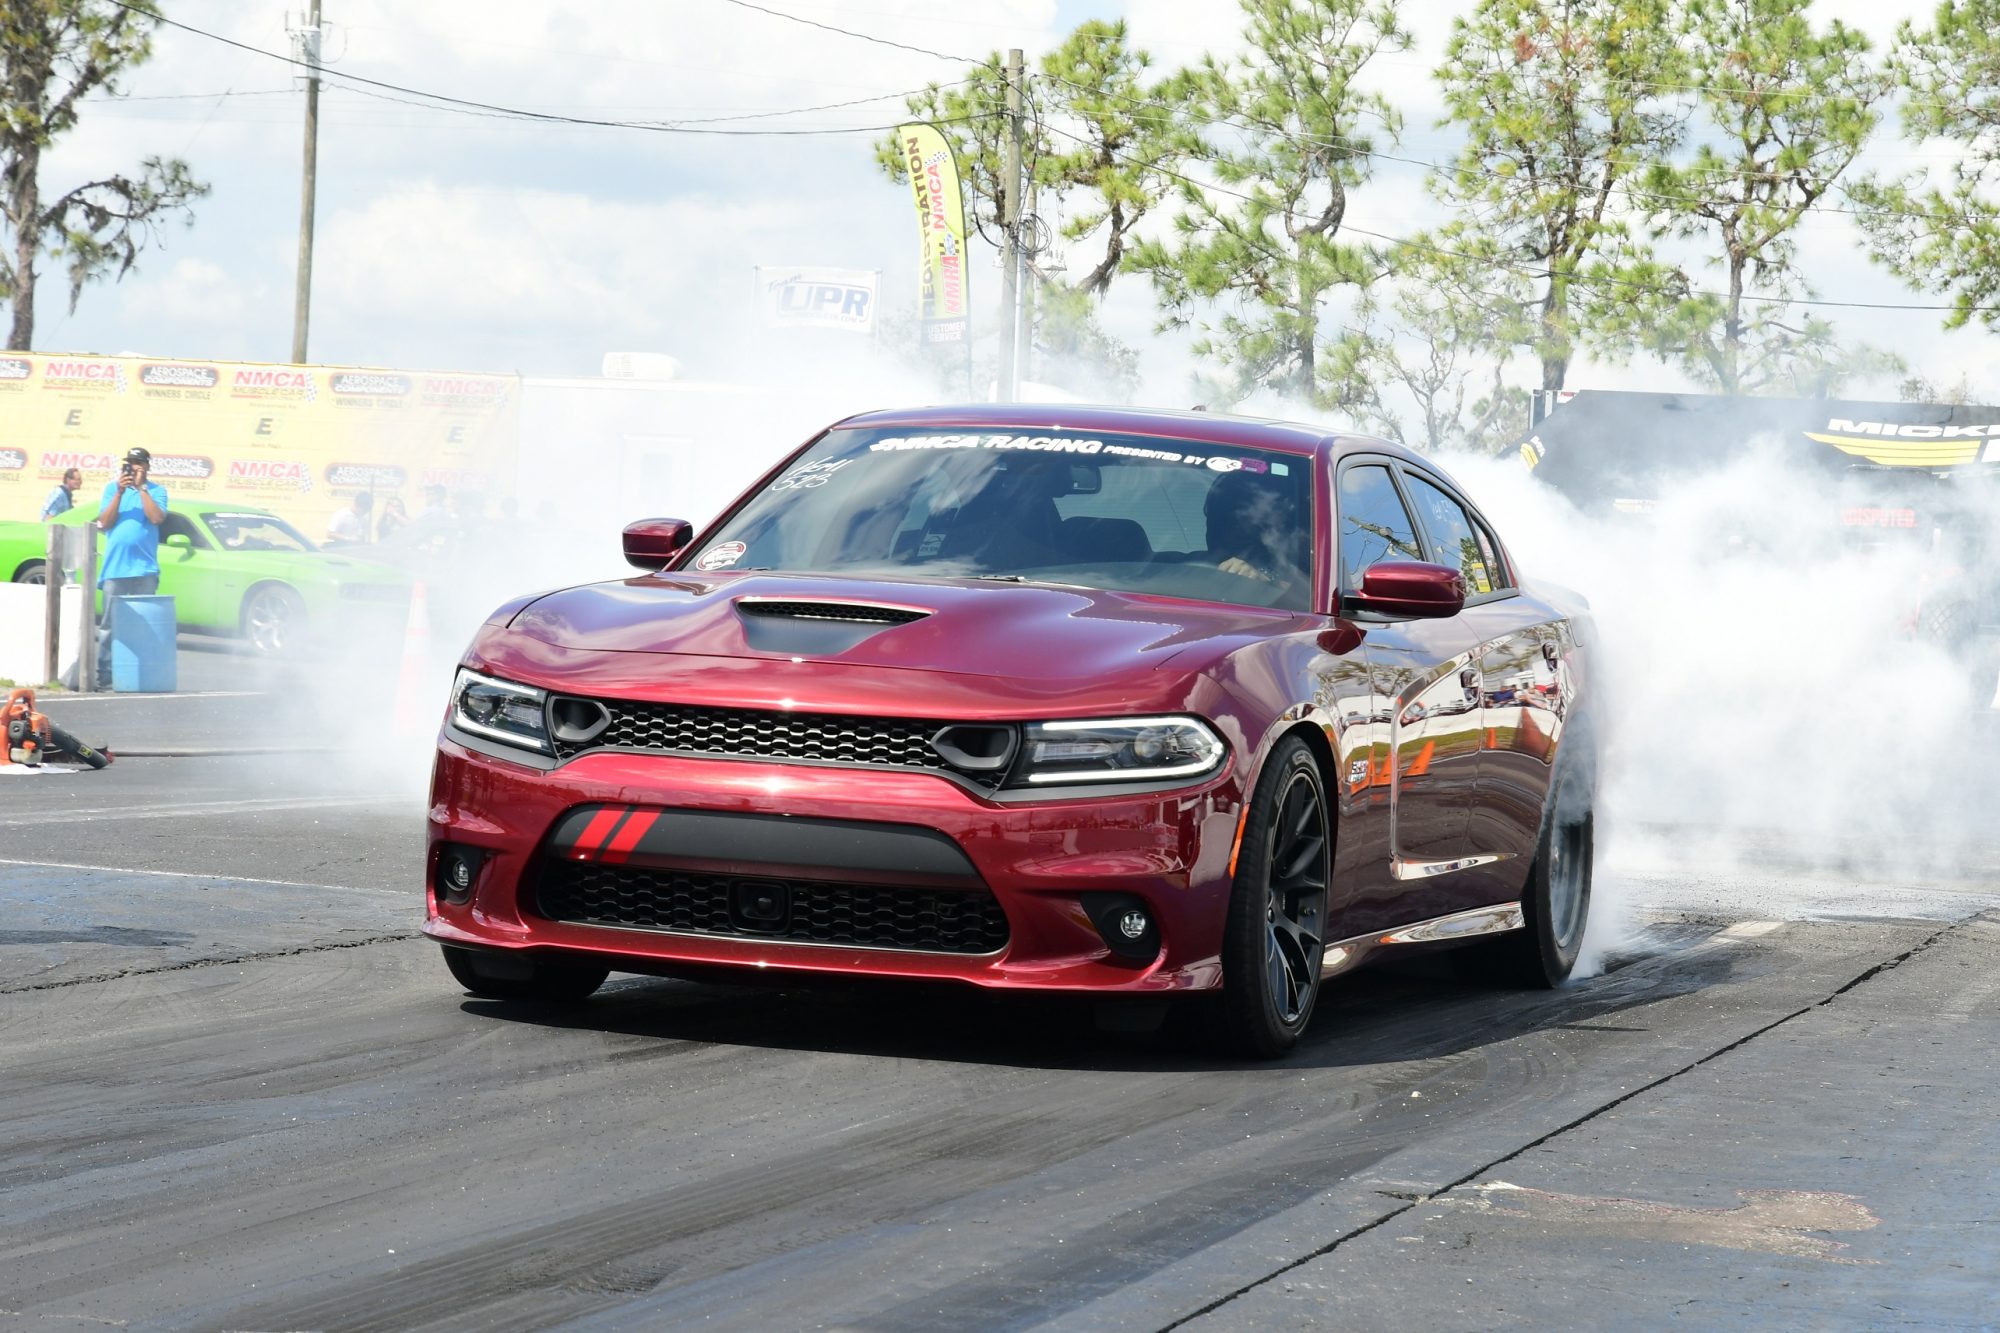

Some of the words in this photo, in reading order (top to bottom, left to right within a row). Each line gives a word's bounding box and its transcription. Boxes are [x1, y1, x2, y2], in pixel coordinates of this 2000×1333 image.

[927, 164, 945, 229] NMCA
[907, 137, 937, 316] REGISTRATION
[780, 285, 871, 317] UPR
[46, 362, 116, 379] NMCA
[150, 366, 209, 377] AEROSPACE
[235, 371, 306, 387] NMCA
[144, 376, 216, 387] COMPONENTS
[425, 379, 497, 395] NMCA
[144, 388, 182, 399] WINNERS
[184, 390, 211, 400] CIRCLE
[65, 409, 82, 426] E
[255, 418, 273, 435] E
[985, 436, 1104, 455] RACING
[1103, 446, 1182, 463] PRESENTED
[1183, 456, 1206, 468] BY
[42, 453, 112, 470] NMCA
[230, 461, 301, 478] NMCA
